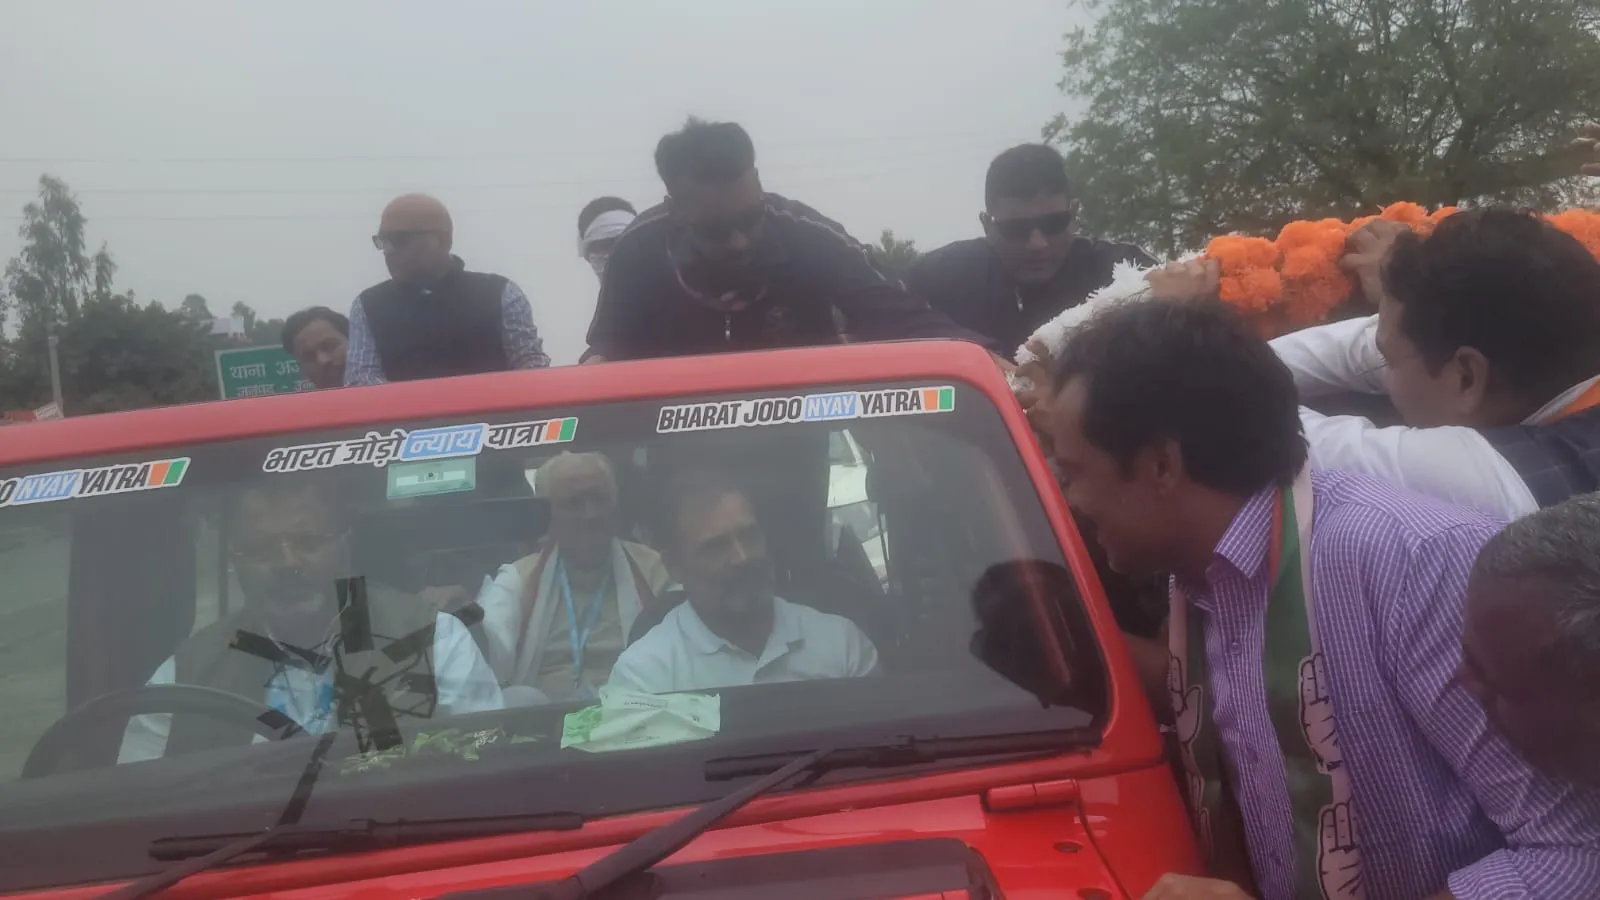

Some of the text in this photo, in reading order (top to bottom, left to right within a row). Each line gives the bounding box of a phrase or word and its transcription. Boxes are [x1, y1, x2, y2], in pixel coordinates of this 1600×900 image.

[229, 363, 267, 379] थाना
[657, 389, 923, 431] BHARAT JODO NYAY YATRA
[266, 420, 549, 471] भारत जोड़ो न्याय यात्रा
[0, 464, 151, 505] O NYAY YATRA
